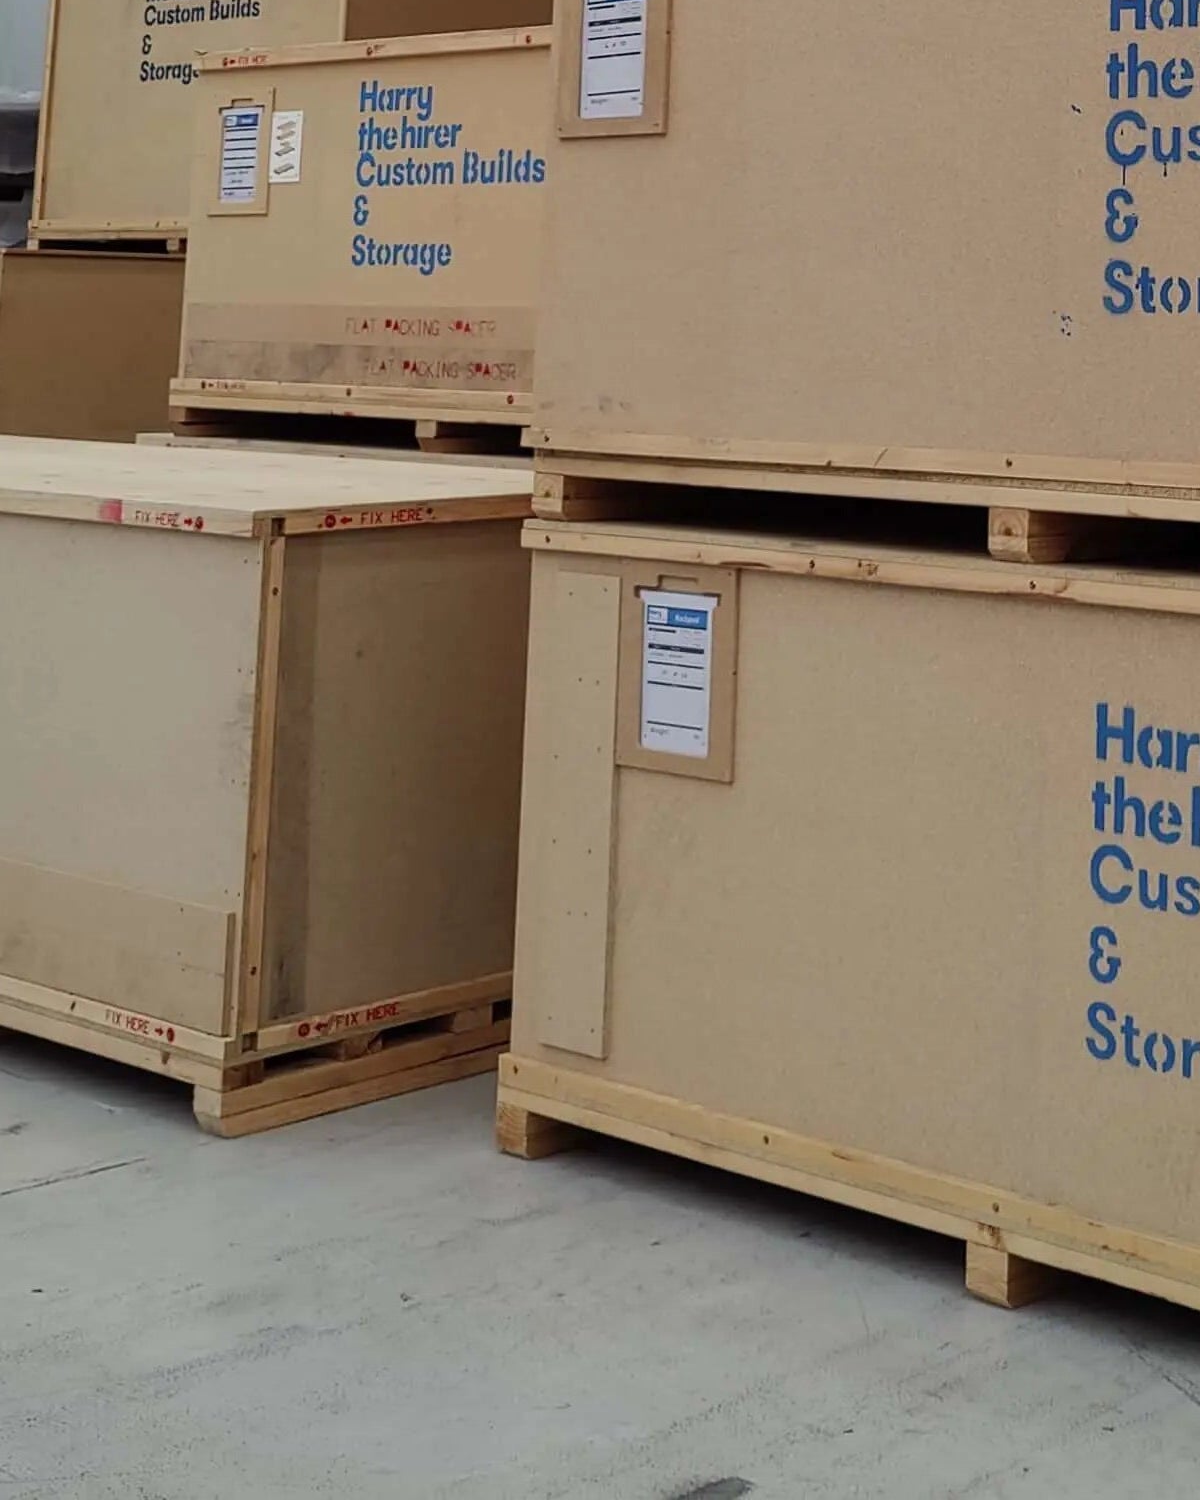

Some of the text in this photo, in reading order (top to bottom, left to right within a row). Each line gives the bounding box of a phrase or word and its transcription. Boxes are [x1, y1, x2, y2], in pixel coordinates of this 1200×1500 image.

[144, 4, 205, 26] Custom
[142, 34, 152, 55] &
[359, 81, 433, 121] Harry
[356, 148, 545, 188] Custom Builds
[353, 194, 369, 227] &
[1105, 187, 1138, 243] &
[351, 234, 452, 276] Storage
[360, 506, 423, 525] FIX HERE
[1088, 926, 1120, 984] &
[105, 1009, 150, 1034] FIX HERE
[335, 1001, 400, 1028] FIX HERE
